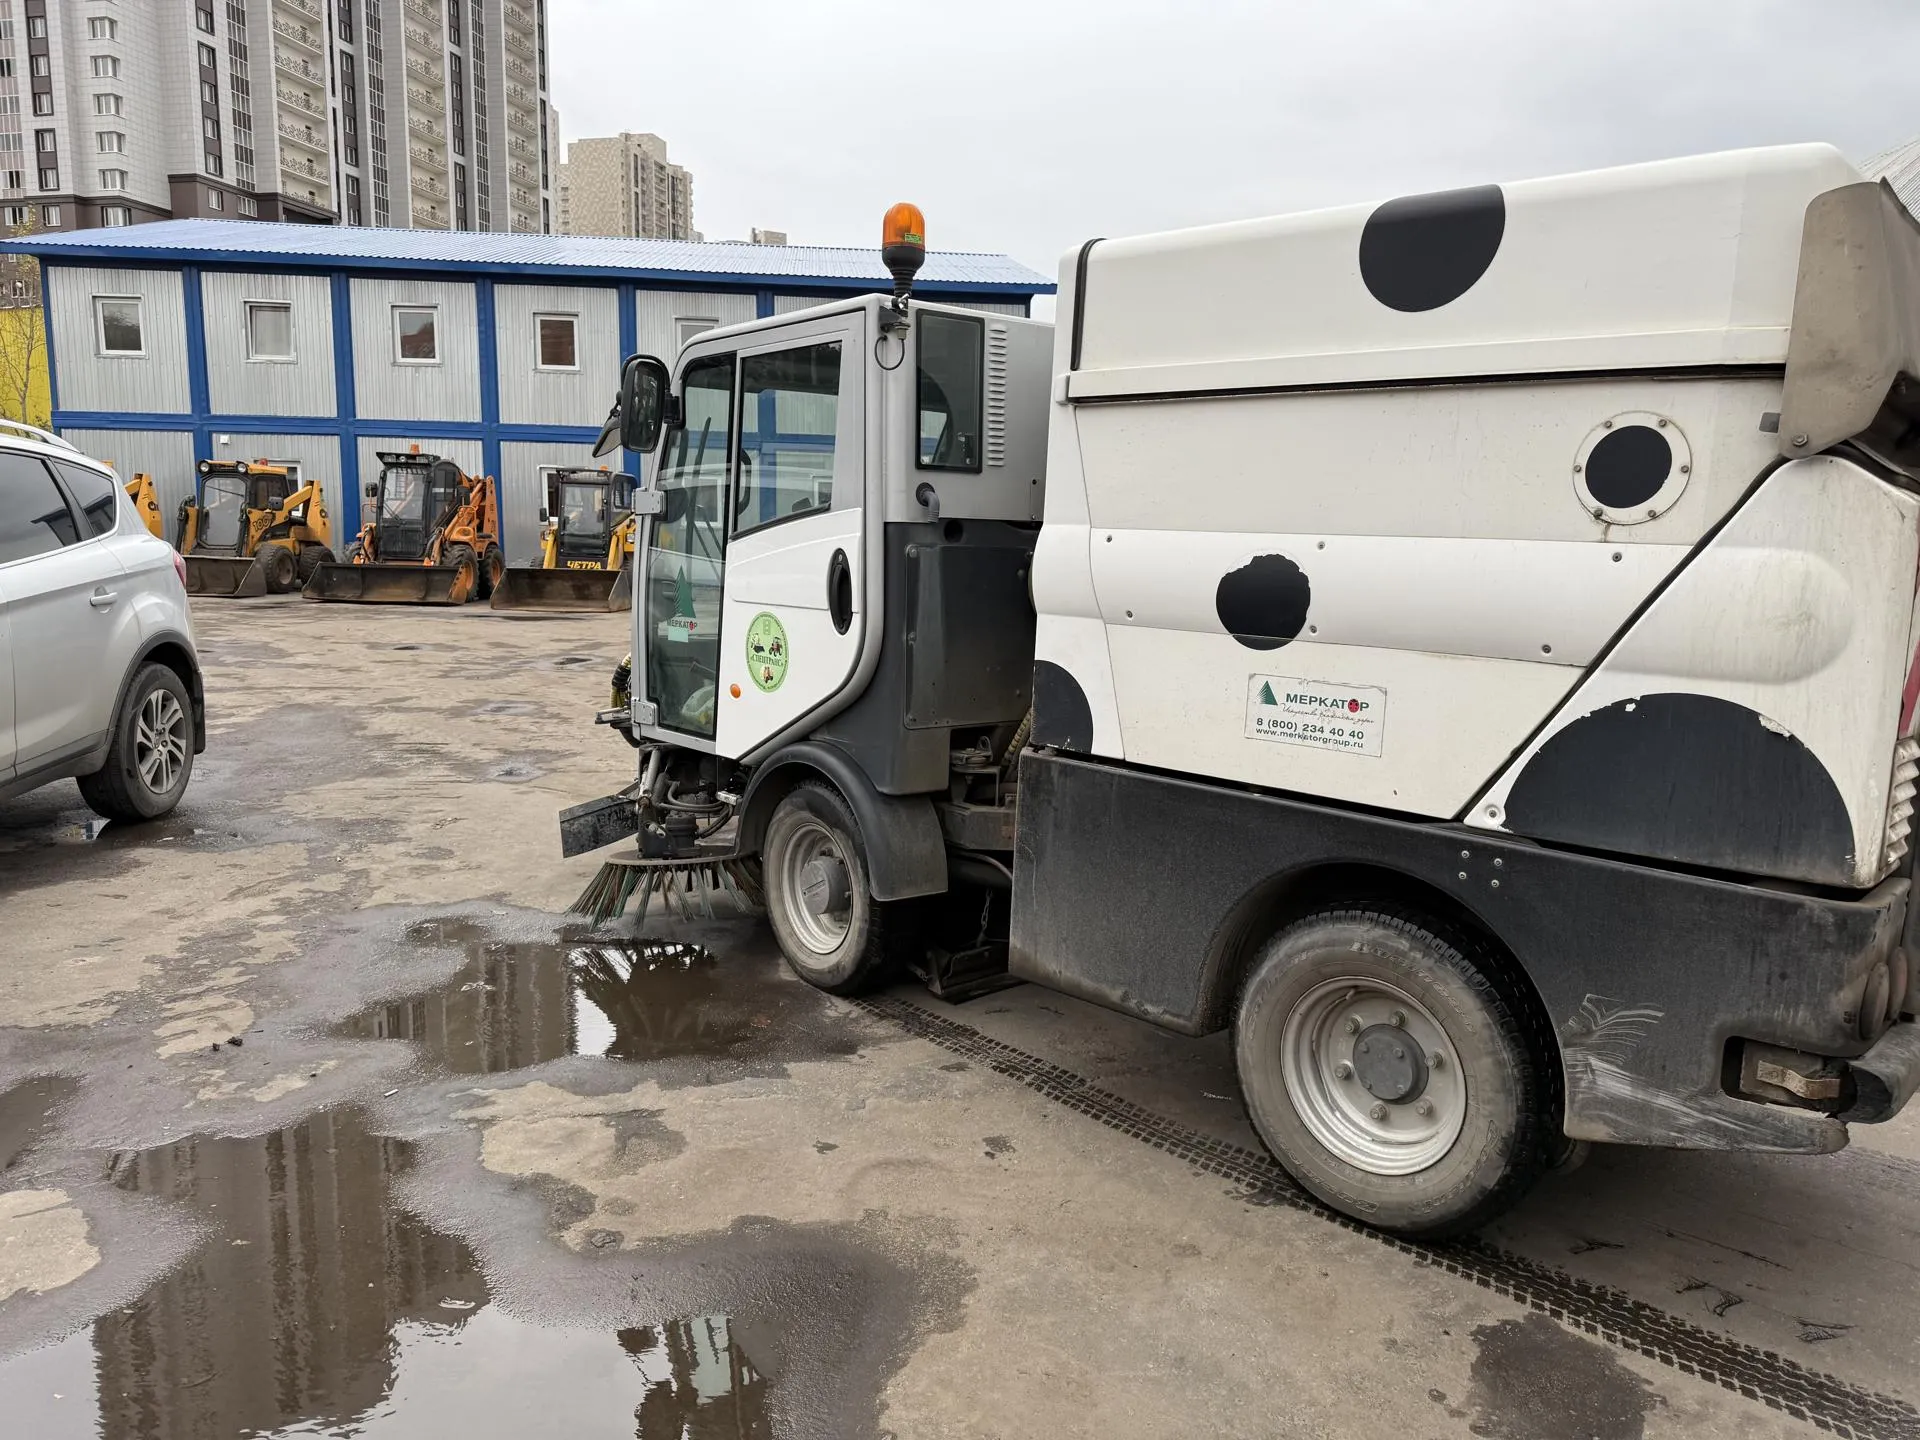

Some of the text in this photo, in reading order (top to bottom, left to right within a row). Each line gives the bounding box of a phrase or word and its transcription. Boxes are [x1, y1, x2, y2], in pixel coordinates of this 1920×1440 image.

[567, 560, 602, 570] ЧЕТРА
[1285, 693, 1370, 713] МЕРКАТОР
[1255, 728, 1364, 748] www.merkatorgroup.ru
[1256, 718, 1364, 740] 8 (800) 234 40 40
